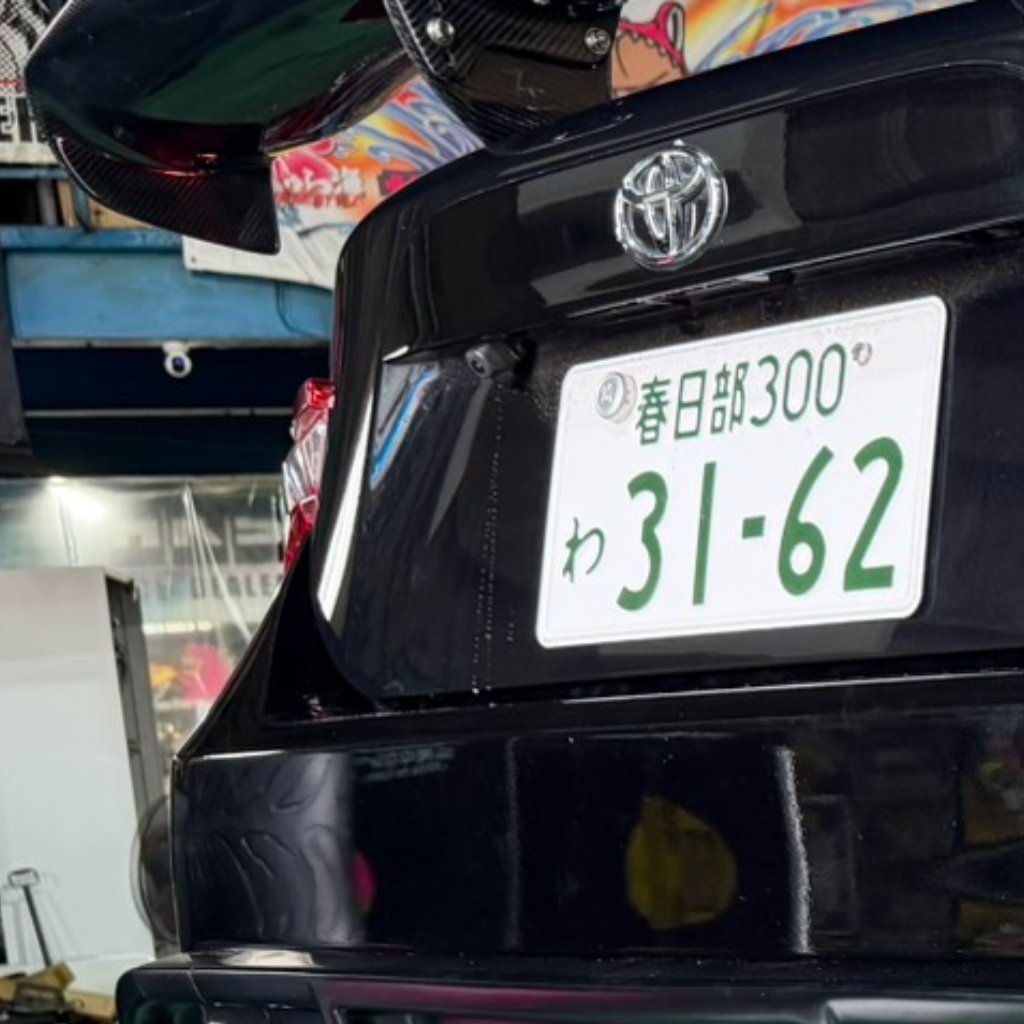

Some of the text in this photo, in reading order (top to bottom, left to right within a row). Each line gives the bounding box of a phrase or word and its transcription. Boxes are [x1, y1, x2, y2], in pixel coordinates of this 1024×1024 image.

[635, 342, 846, 446] 春日部300
[562, 436, 905, 612] わ 31-62
